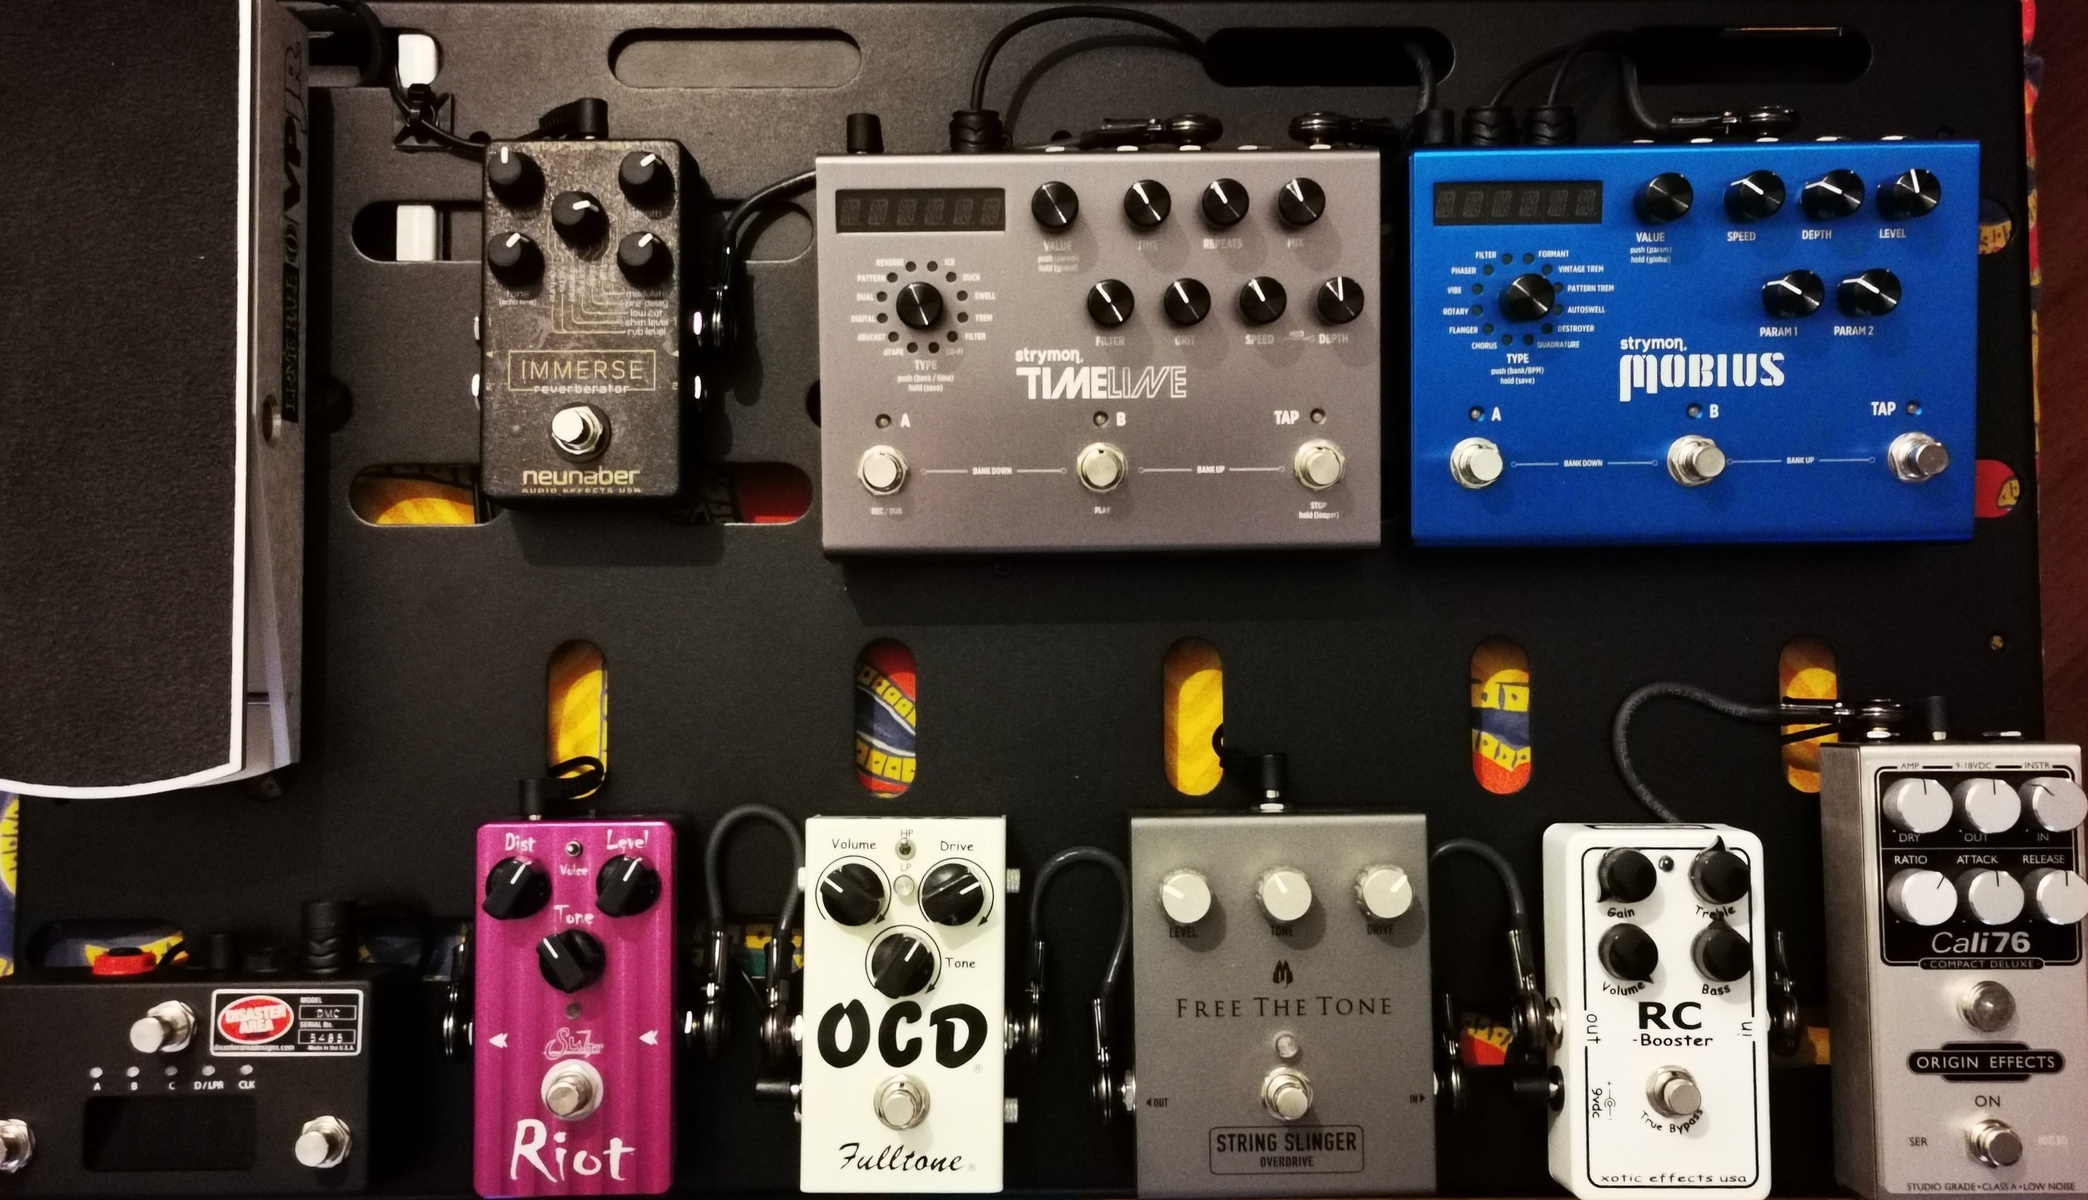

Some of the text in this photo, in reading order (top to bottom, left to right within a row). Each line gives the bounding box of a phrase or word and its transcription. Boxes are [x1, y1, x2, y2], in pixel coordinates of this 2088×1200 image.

[1636, 232, 1666, 243] VALUE
[1726, 231, 1756, 242] SPEED
[1802, 229, 1832, 240] DEPTH
[1878, 228, 1906, 239] LEVEL
[1203, 238, 1242, 250] REPEATS
[1476, 251, 1497, 260] FILTER
[1538, 250, 1569, 258] FORMANT
[1630, 246, 1646, 254] push
[1630, 256, 1646, 264] hold
[1451, 266, 1476, 275] PHASER
[1558, 265, 1604, 274] VINTAGE TREM
[1447, 286, 1462, 294] VIBE
[1567, 284, 1614, 292] PATTERN TREM
[1442, 308, 1469, 316] ROTARY
[1567, 306, 1606, 314] AUTOSWELL
[1449, 326, 1478, 334] FLANGER
[1558, 325, 1595, 333] DESTROYER
[1760, 326, 1790, 337] PARAM
[1834, 326, 1874, 336] PARAM 2
[1095, 336, 1125, 346] FILTER
[1245, 334, 1274, 344] SPEED
[1318, 334, 1349, 344] DEPTH
[1536, 340, 1580, 349] QUADRATURE
[1472, 342, 1498, 350] CHORUS
[1506, 353, 1530, 364] TYPE
[522, 360, 644, 380] IMMERSE
[914, 360, 938, 371] TYPE
[1490, 367, 1506, 376] push
[1016, 366, 1187, 400] TIMELINE
[1500, 376, 1536, 386] hold (save)
[534, 384, 630, 394] reverberator
[1491, 407, 1502, 422] A
[1709, 404, 1719, 418] B
[1871, 402, 1896, 416] TAP
[900, 414, 910, 428] A
[1116, 412, 1126, 426] B
[1274, 410, 1300, 424] TAP
[1564, 459, 1603, 467] BANK DOWN
[1786, 456, 1815, 464] BANK UP
[972, 466, 1012, 476] BANK DOWN
[1196, 466, 1226, 474] BANK UP
[522, 466, 640, 486] neunaber
[1955, 762, 1992, 770] 9-18VDC
[2024, 762, 2050, 770] INSTR
[900, 829, 914, 838] HP
[1898, 833, 1920, 842] DRY
[1964, 833, 1988, 842] OUT
[2037, 833, 2050, 842] IN
[504, 832, 536, 852] Dist
[606, 829, 650, 854] Level
[831, 838, 877, 850] Volume
[940, 840, 974, 852] Drive
[1894, 855, 1928, 865] RATIO
[1956, 855, 1999, 864] ATTACK
[2022, 854, 2065, 864] RELEASE
[560, 864, 588, 876] Voice
[900, 863, 912, 872] LP
[553, 904, 595, 926] Tone
[1606, 906, 1636, 920] Gain
[1695, 905, 1737, 920] Treble
[1169, 926, 1198, 938] LEVEL
[1270, 924, 1294, 937] TONE
[1366, 923, 1394, 936] DRIVE
[945, 957, 976, 969] Tone
[1930, 960, 2034, 969] COMPACT DELUXE
[1602, 980, 1646, 996] Volume
[1702, 984, 1731, 997] Bass
[316, 1008, 340, 1018] DMC
[1176, 996, 1392, 1019] FREE THE TONE
[224, 1004, 287, 1024] DISASTER
[1638, 1002, 1703, 1030] RC
[238, 1018, 274, 1034] AREA
[1586, 1013, 1602, 1044] out
[1737, 1020, 1753, 1038] in
[817, 998, 988, 1069] OCD
[1916, 1056, 2056, 1069] ORIGIN EFFECTS
[94, 1082, 102, 1090] A
[130, 1082, 138, 1090] B
[168, 1081, 176, 1090] C
[238, 1080, 256, 1089] CLK
[1153, 1098, 1168, 1108] OUT
[1410, 1094, 1418, 1104] IN
[1592, 1087, 1603, 1119] 9vdc
[1974, 1095, 2001, 1108] ON
[1641, 1108, 1704, 1134] True Bypass
[1216, 1132, 1357, 1152] STRING SLINGER
[1909, 1136, 1928, 1147] SER
[510, 1118, 636, 1183] Riot
[838, 1142, 964, 1172] Fulltone
[1260, 1156, 1314, 1168] OVERDRIVE
[1600, 1172, 1747, 1184] xotic effects usa
[1906, 1182, 1942, 1192] STUDIO
[1982, 1182, 2010, 1191] CLASS
[2023, 1182, 2046, 1191] LOW
[2048, 1182, 2075, 1191] NOISE
